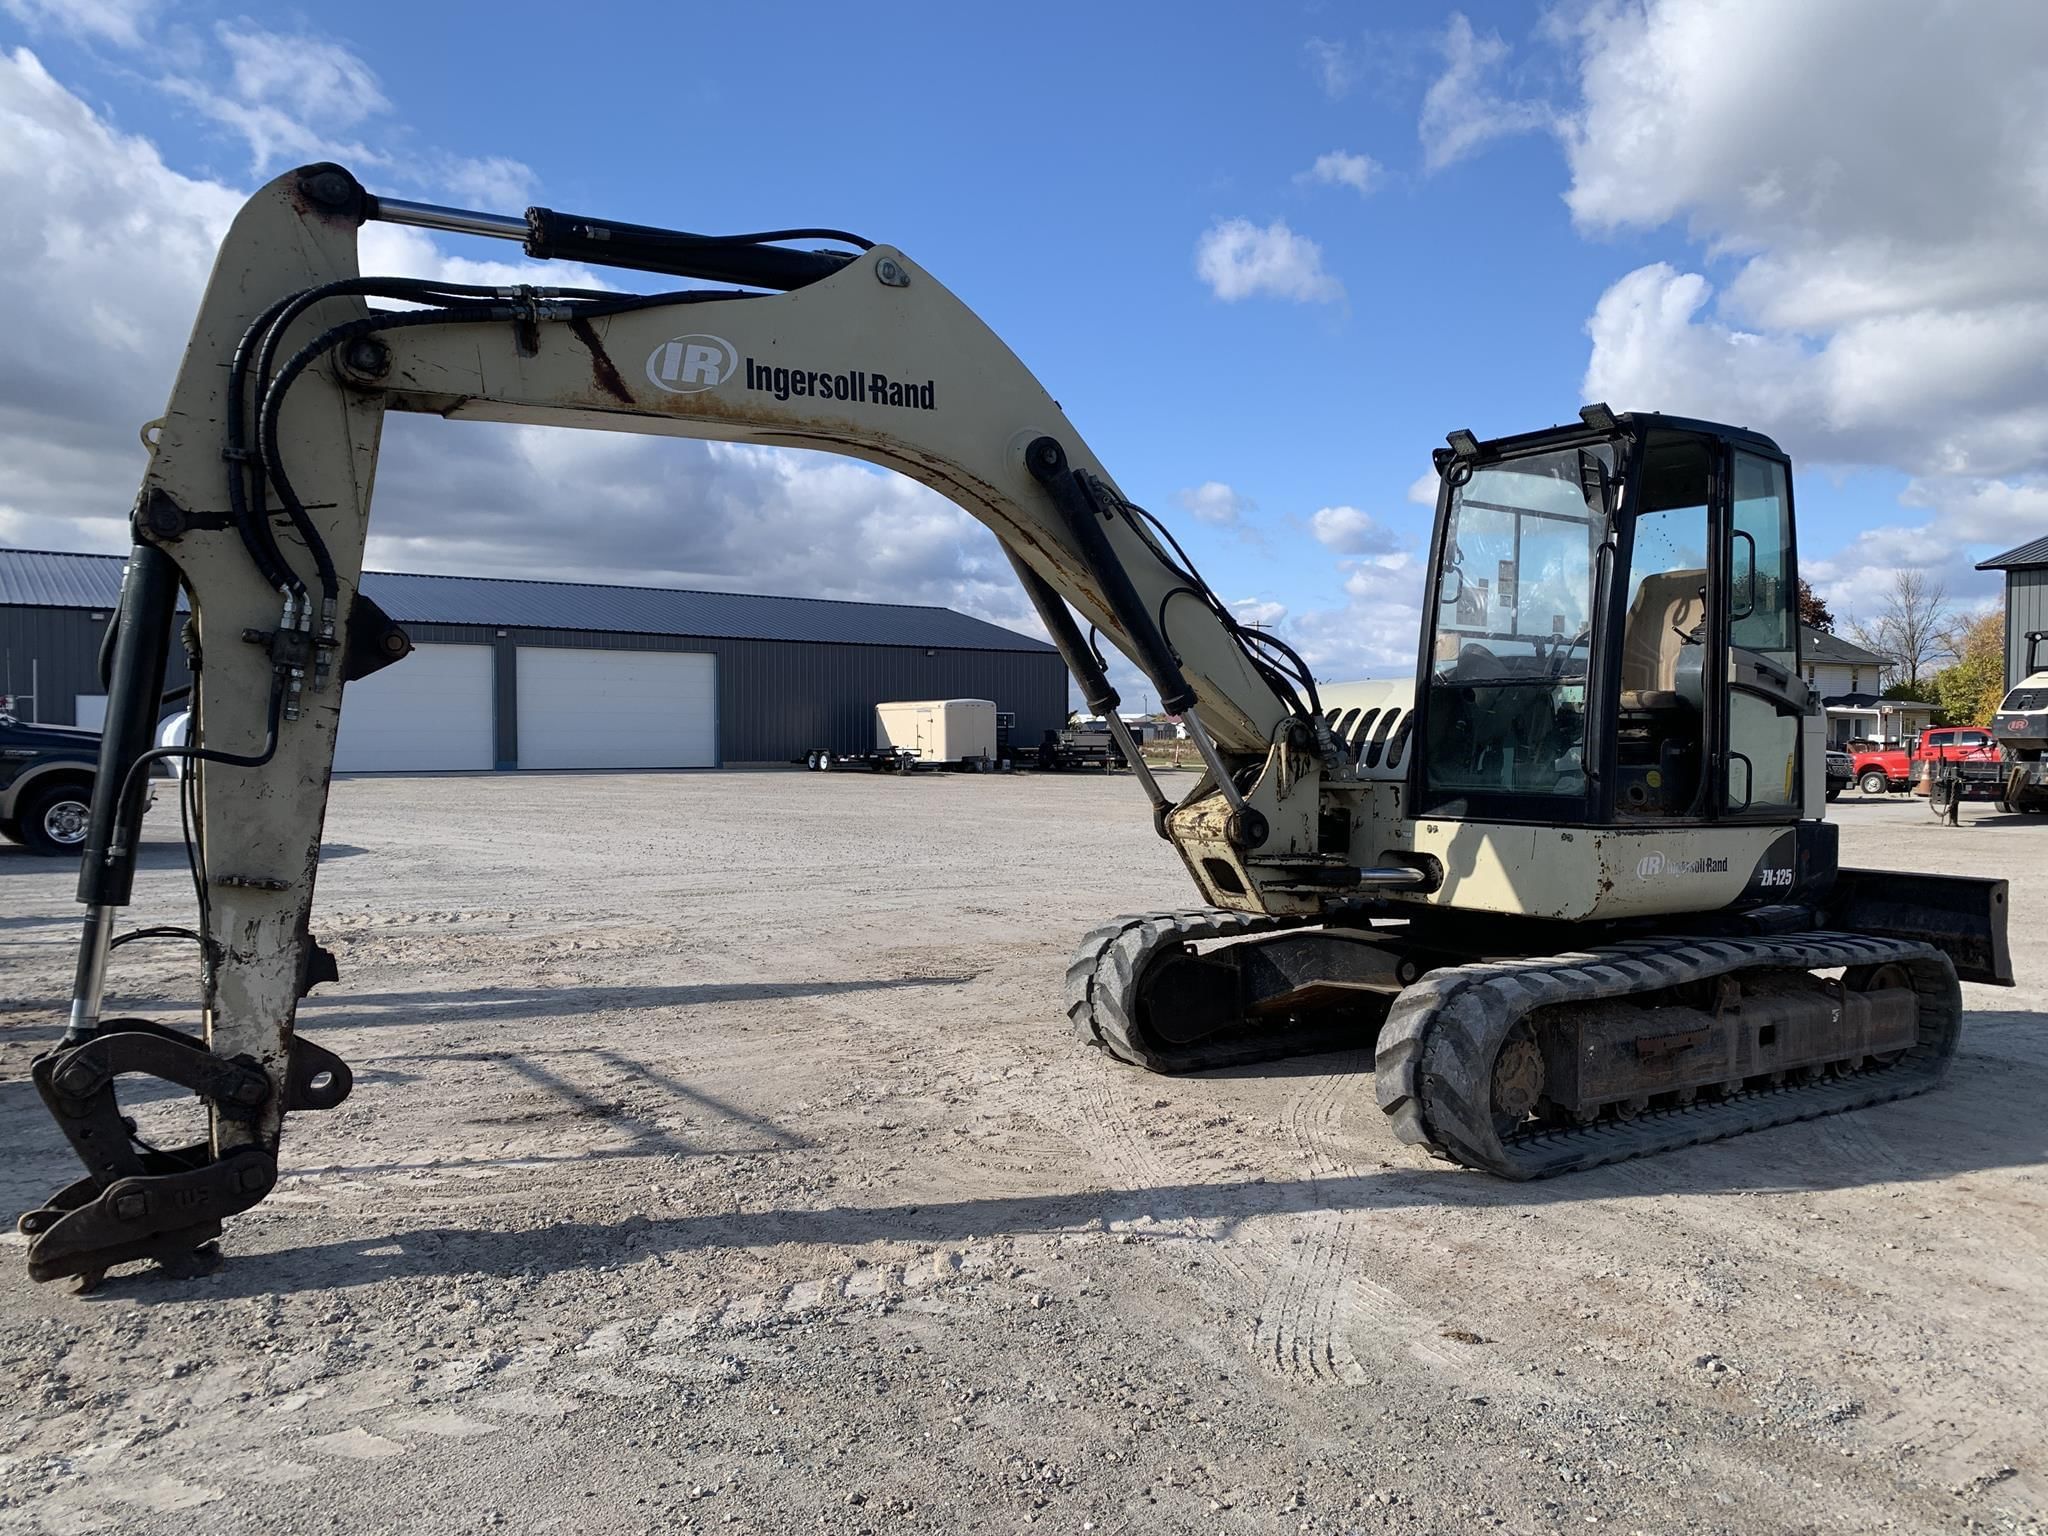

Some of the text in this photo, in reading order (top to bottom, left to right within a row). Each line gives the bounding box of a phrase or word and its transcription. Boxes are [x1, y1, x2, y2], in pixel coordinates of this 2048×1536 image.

[661, 342, 723, 386] IR
[1641, 856, 1661, 876] IR
[1761, 869, 1793, 886] ZX-125
